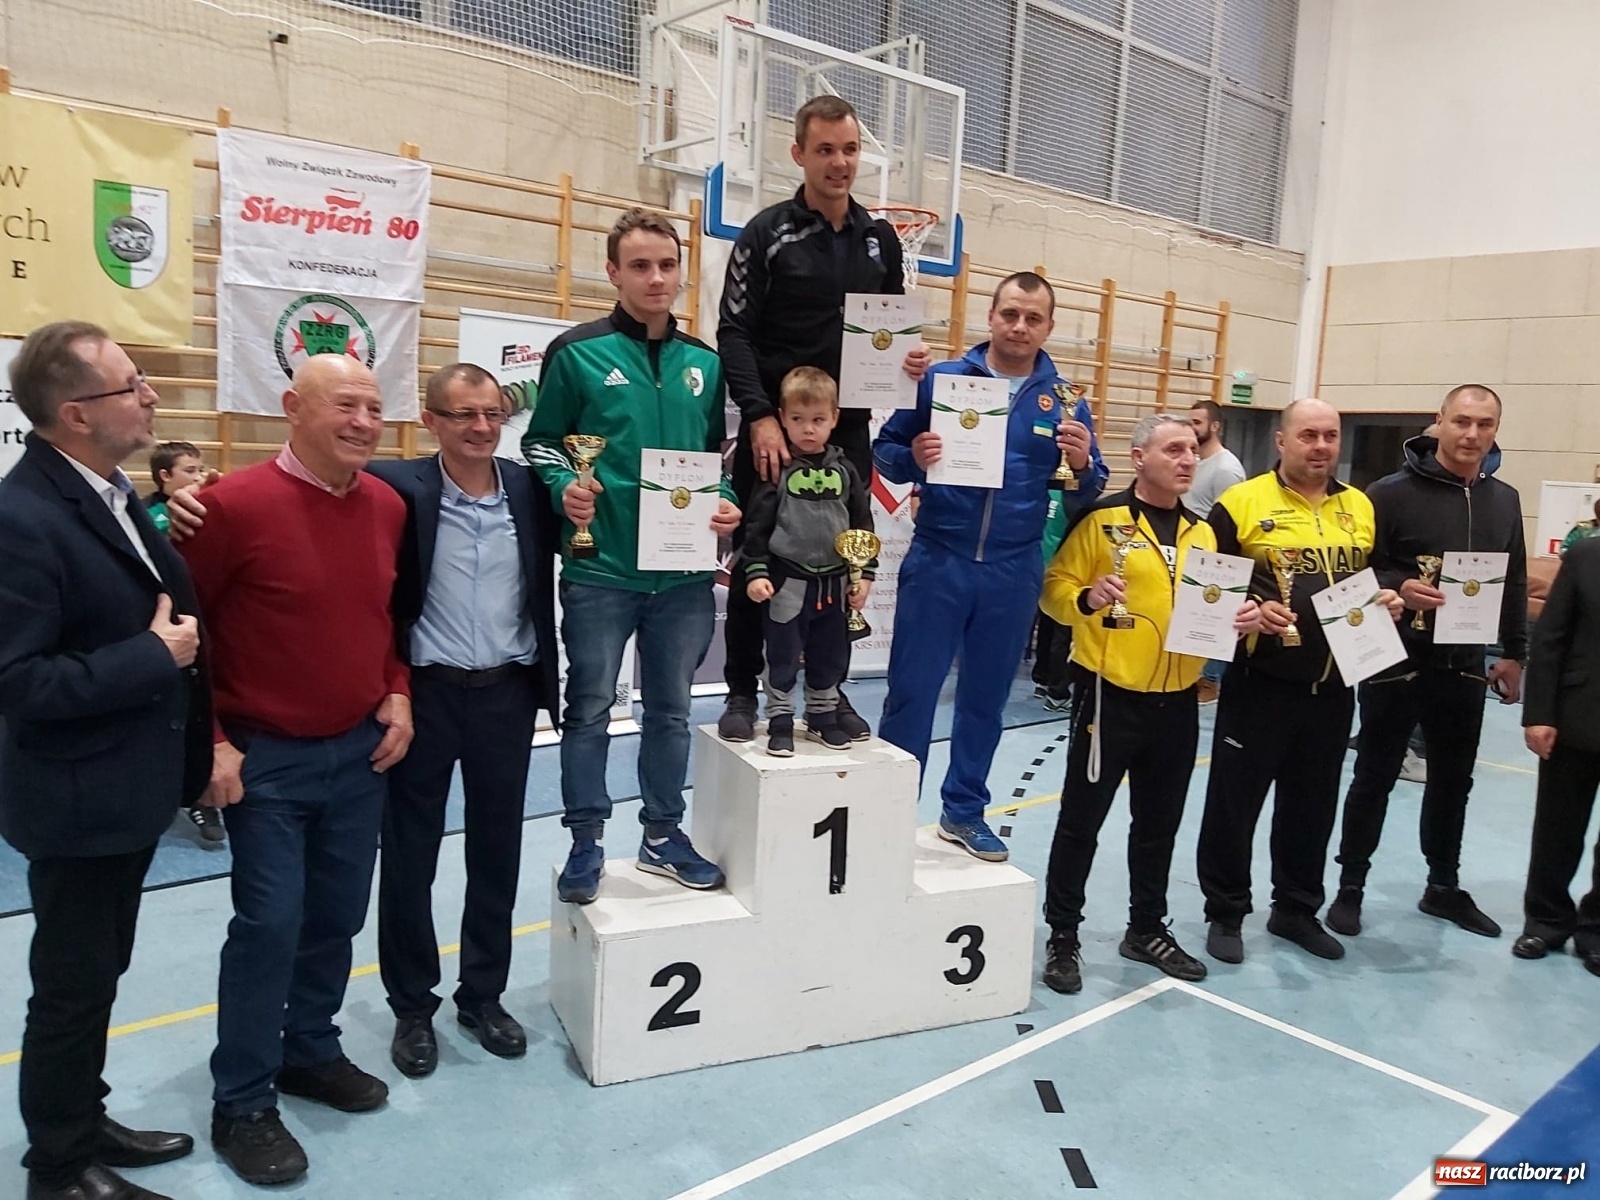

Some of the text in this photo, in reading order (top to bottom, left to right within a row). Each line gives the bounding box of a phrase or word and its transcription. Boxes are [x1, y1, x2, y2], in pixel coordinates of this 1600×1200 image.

[266, 156, 398, 188] Wolny Związek Zawodowy
[0, 207, 51, 243] ch
[240, 196, 420, 240] Sierpień 80
[288, 258, 378, 279] KONFEDERACJA
[305, 323, 346, 339] ZZRG
[813, 806, 849, 894] 1
[943, 924, 985, 985] 3
[647, 961, 701, 1032] 2
